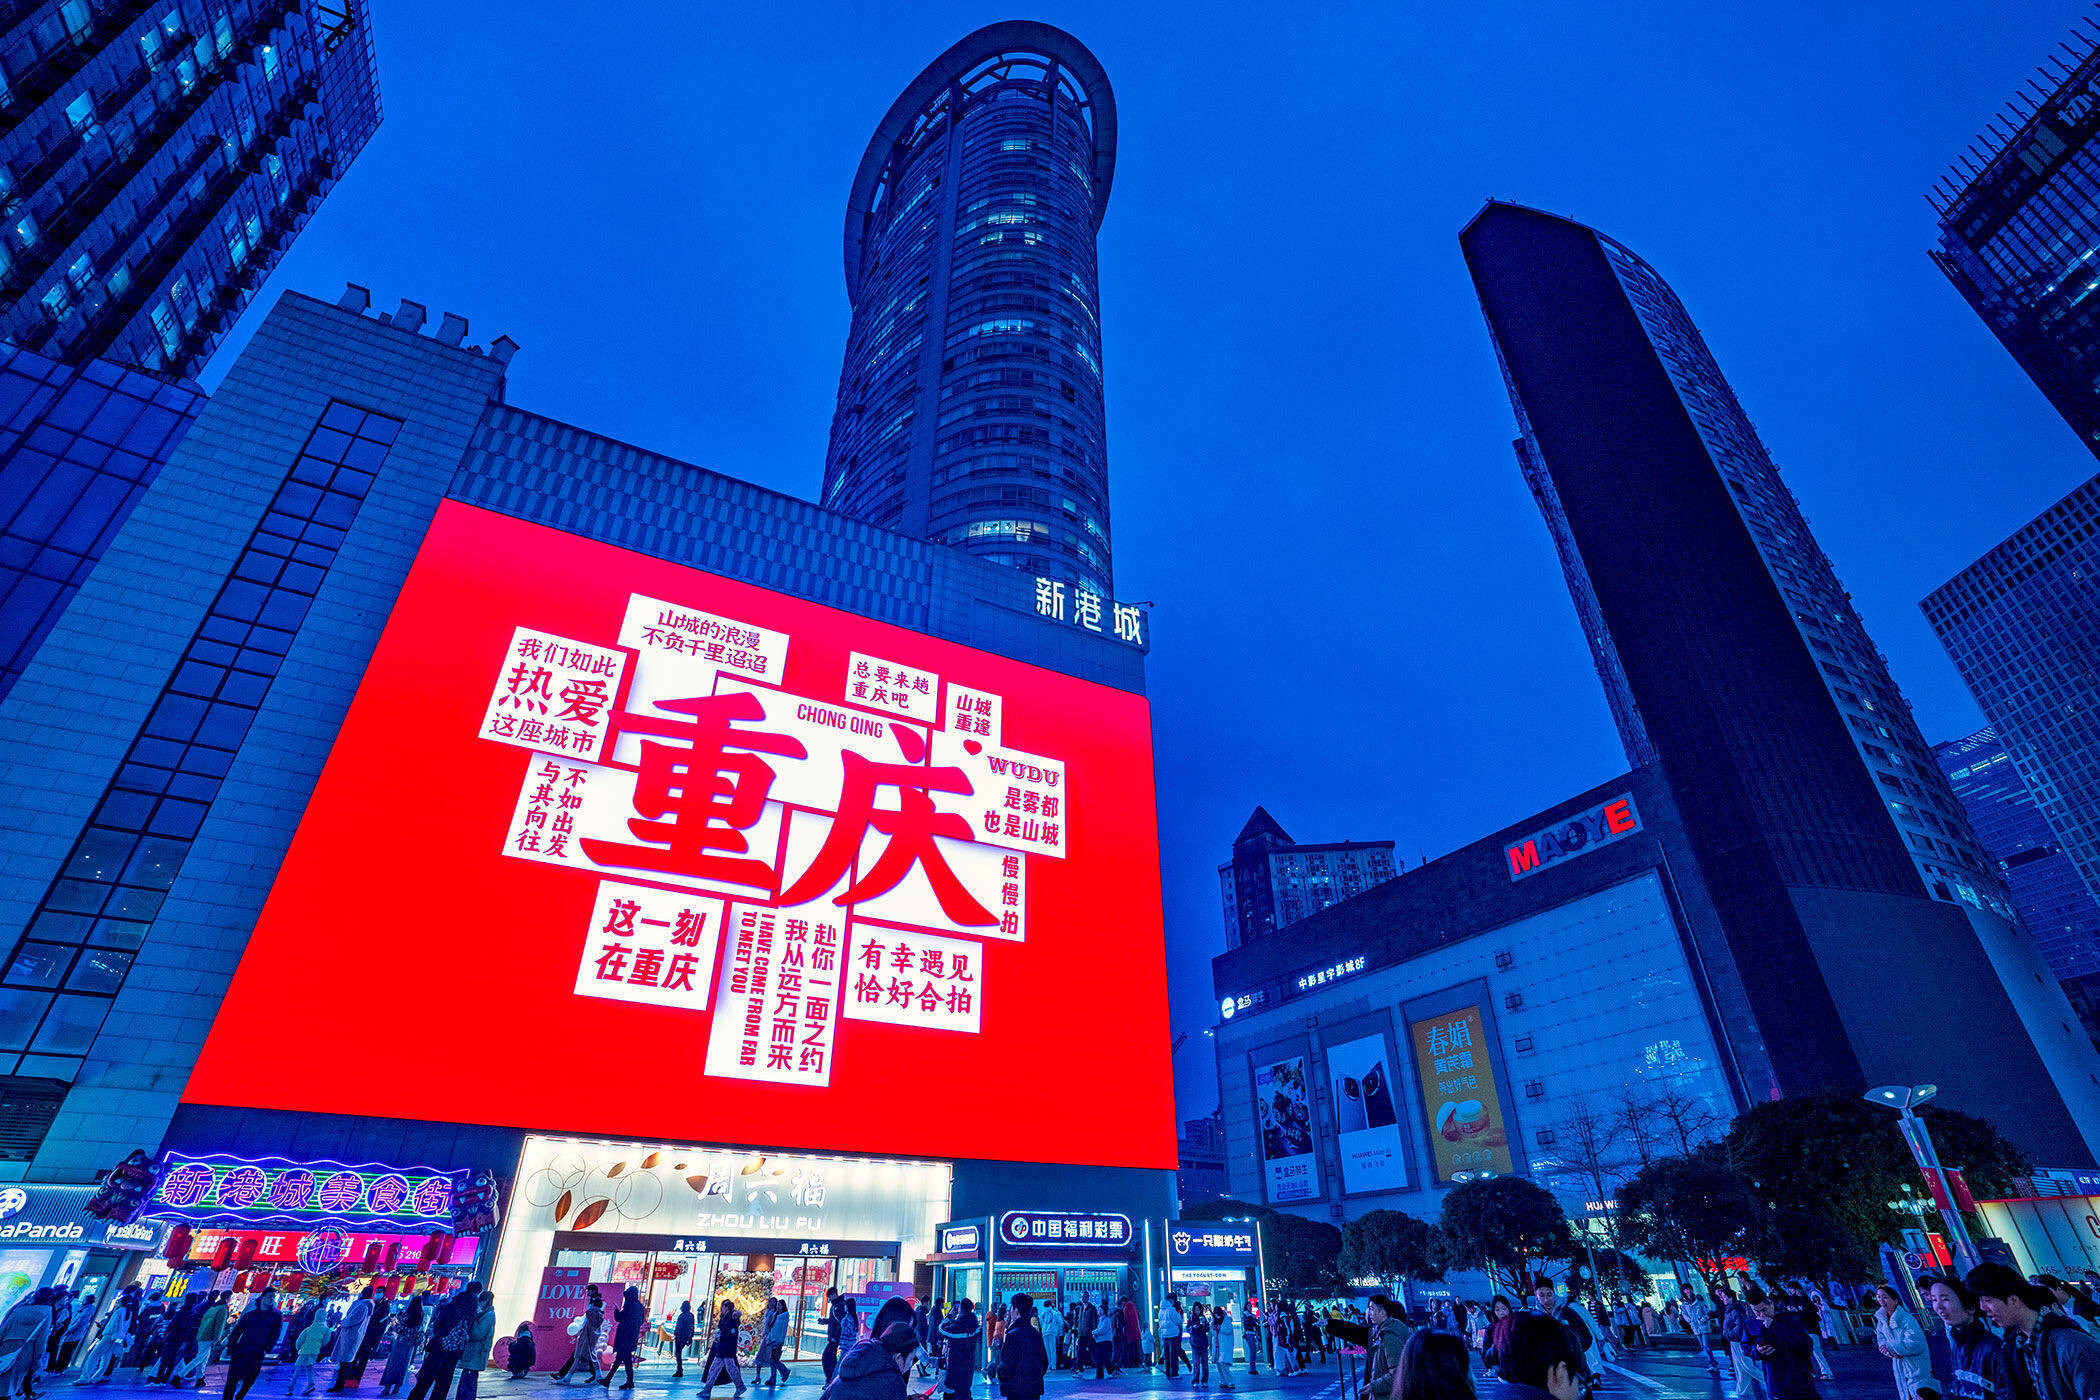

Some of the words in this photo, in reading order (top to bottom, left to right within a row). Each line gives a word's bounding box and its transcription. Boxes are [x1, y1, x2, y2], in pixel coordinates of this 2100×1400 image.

[657, 608, 762, 653] 山城的浪漫
[1035, 576, 1143, 645] 新港城
[517, 637, 618, 678] 我们如此
[640, 624, 769, 675] 不负千里迢迢
[497, 661, 610, 727] 热爱
[851, 681, 910, 710] 重庆吧
[853, 660, 930, 695] 总要来趟
[797, 702, 847, 731] CHONG
[850, 716, 884, 739] QING
[956, 693, 992, 717] 山城
[488, 711, 598, 754] 这座城市
[954, 713, 992, 738] 重逢
[987, 756, 1060, 788] WUDU
[515, 760, 561, 854] 与其向往
[542, 766, 589, 859] 不如出发
[579, 691, 1001, 927] 重庆
[1004, 786, 1060, 818] 是雾都
[983, 810, 1060, 847] 也是山城
[1508, 799, 1636, 875] MAOYE
[1000, 854, 1020, 936] 慢慢拍
[602, 898, 707, 949] 这一刻
[741, 911, 758, 928] TO
[756, 920, 775, 955] HAVE
[735, 929, 754, 965] MEET
[857, 938, 974, 984] 有幸遇见
[594, 942, 699, 993] 在重庆
[730, 967, 749, 994] YOU
[750, 956, 770, 996] COME
[766, 918, 809, 1072] 我从远方而来
[798, 923, 838, 1074] 赴你一面之约
[854, 972, 973, 1015] 恰好合拍
[743, 997, 764, 1037] FROM
[739, 1039, 758, 1066] FAR
[1425, 1019, 1473, 1057] 春娟
[160, 1168, 452, 1213] 新港城美食街
[696, 1159, 828, 1209] 周六福
[0, 1221, 84, 1238] aPanda
[697, 1212, 754, 1229] ZHOU
[759, 1215, 790, 1230] LIU
[795, 1216, 822, 1231] FU
[1031, 1219, 1123, 1239] 中国福利彩票
[540, 1284, 587, 1300] LOVE
[549, 1307, 576, 1319] YOU
